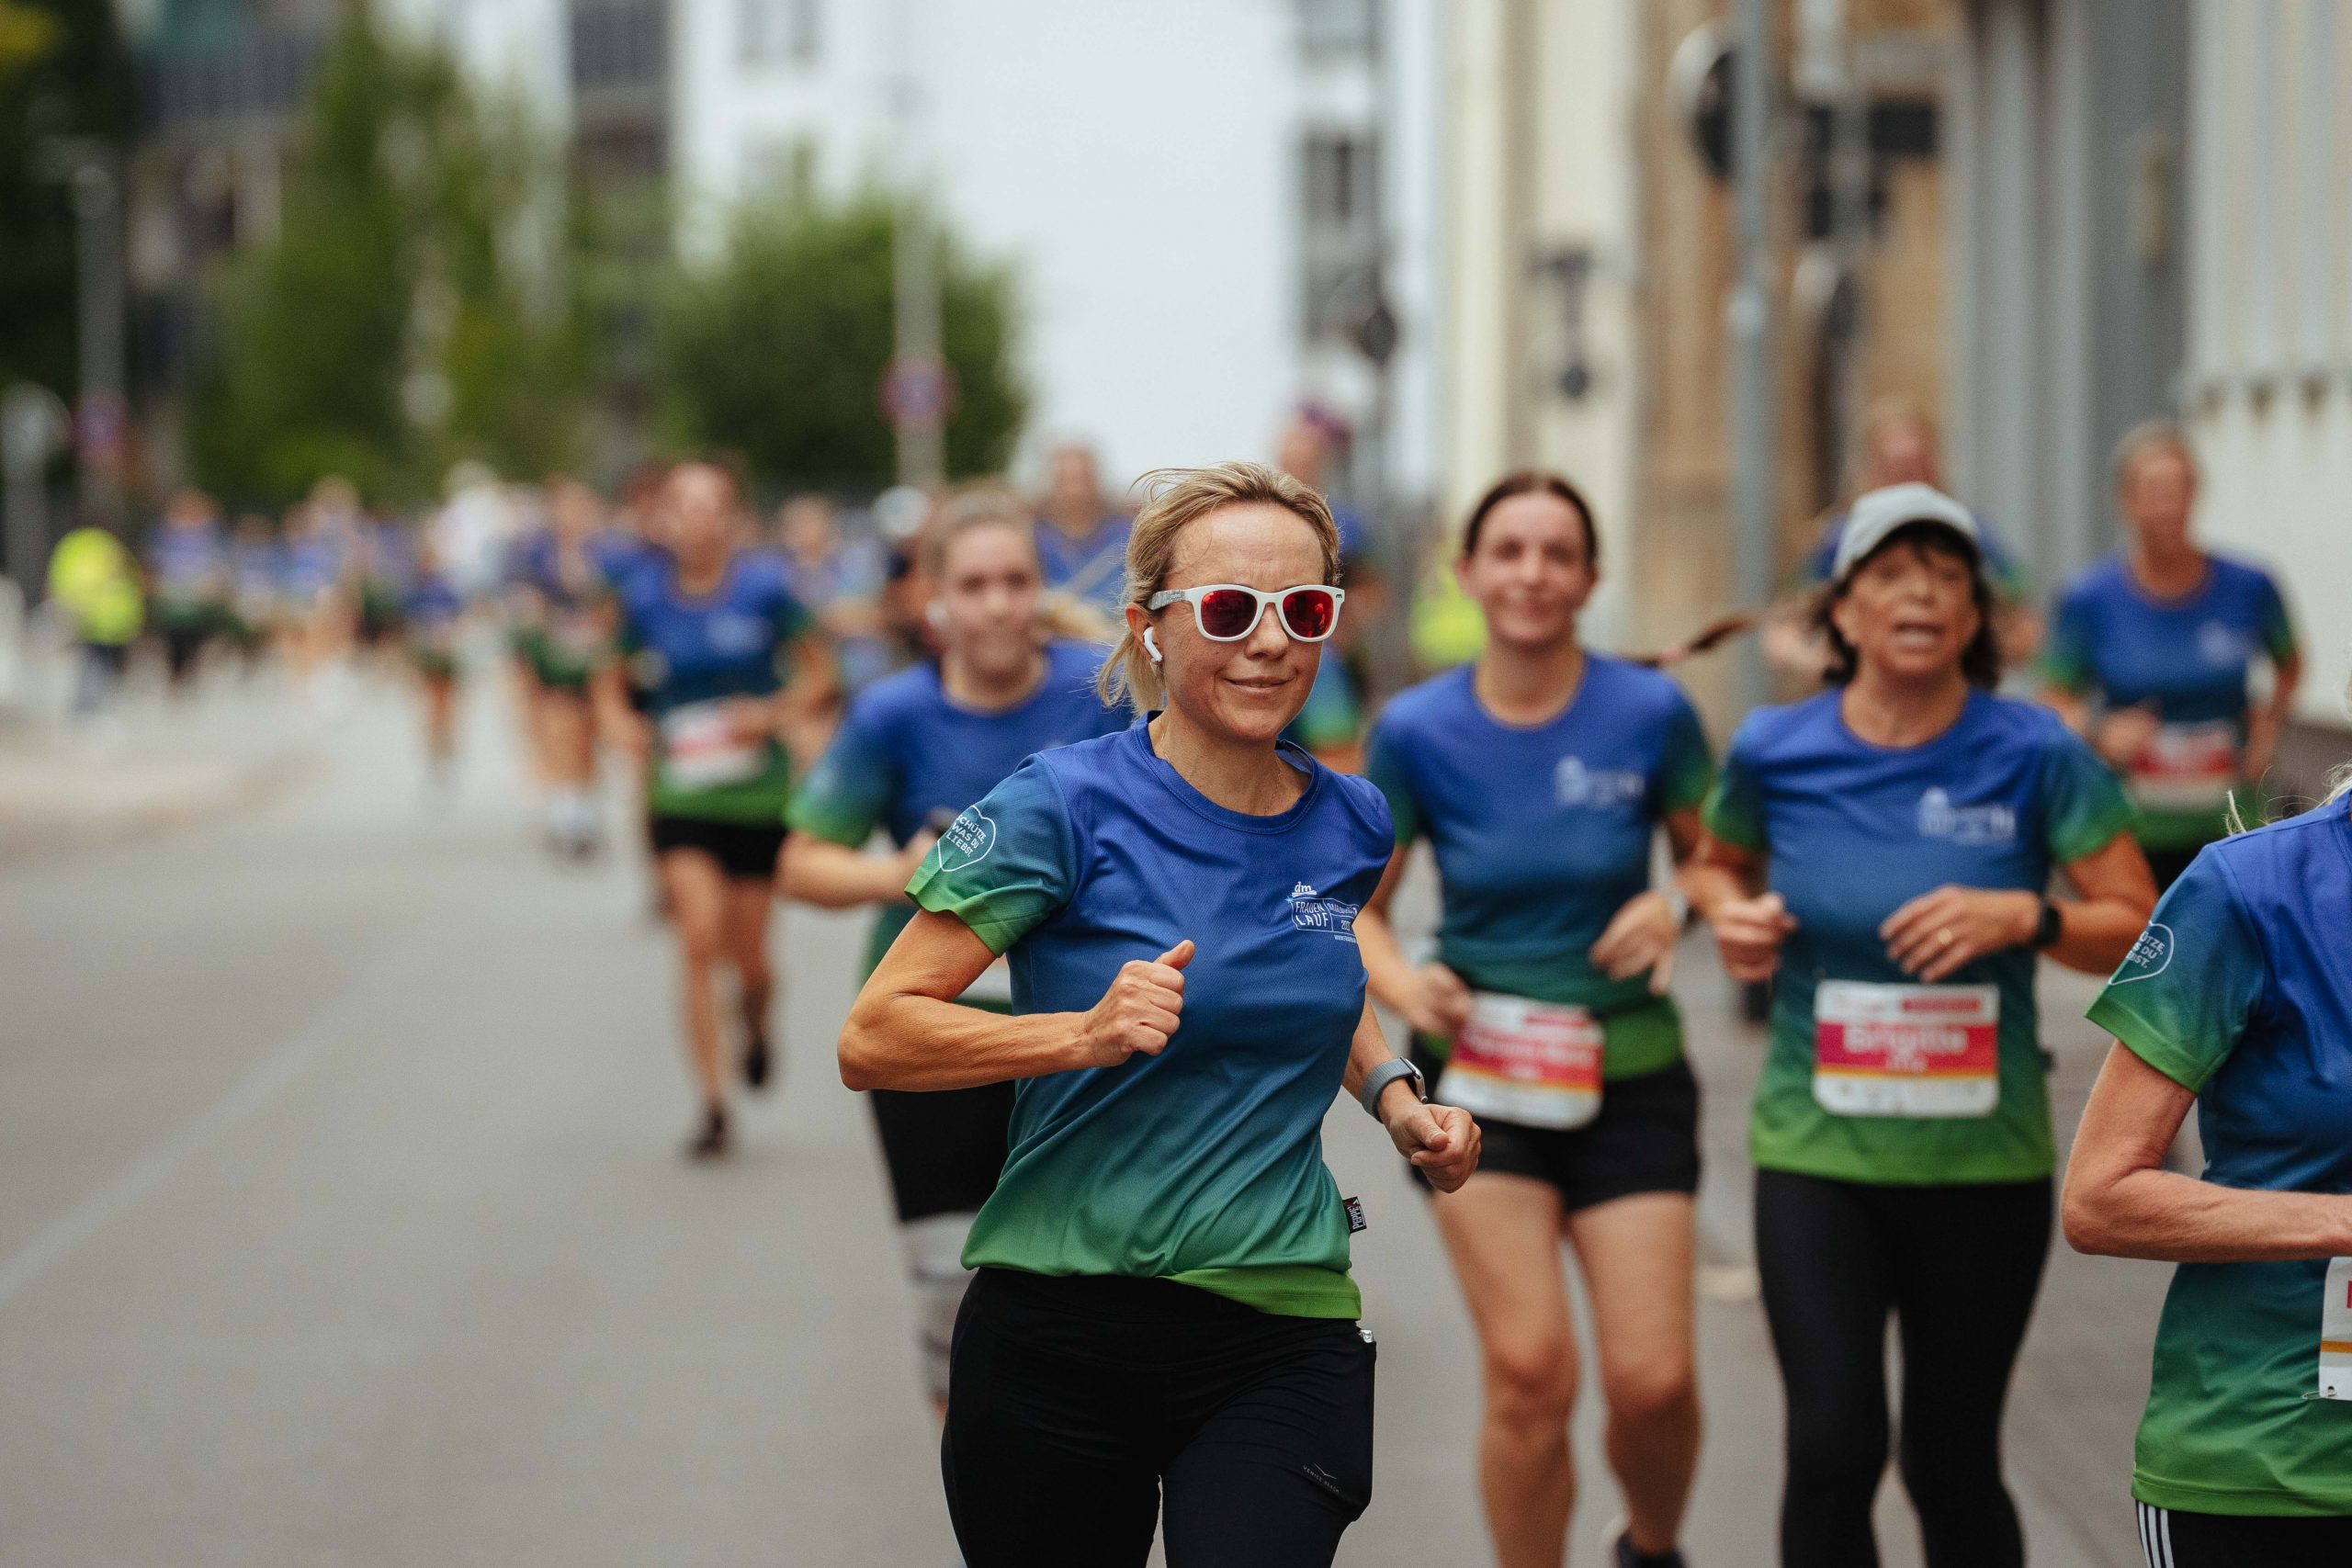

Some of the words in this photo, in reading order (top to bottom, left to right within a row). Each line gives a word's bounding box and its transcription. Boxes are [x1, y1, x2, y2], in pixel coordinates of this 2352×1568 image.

[952, 823, 972, 840] WAS
[971, 839, 979, 849] DU
[1294, 881, 1312, 893] dm
[1295, 901, 1326, 914] FRAUEN
[1295, 912, 1329, 927] LAUF
[2141, 946, 2157, 959] DU
